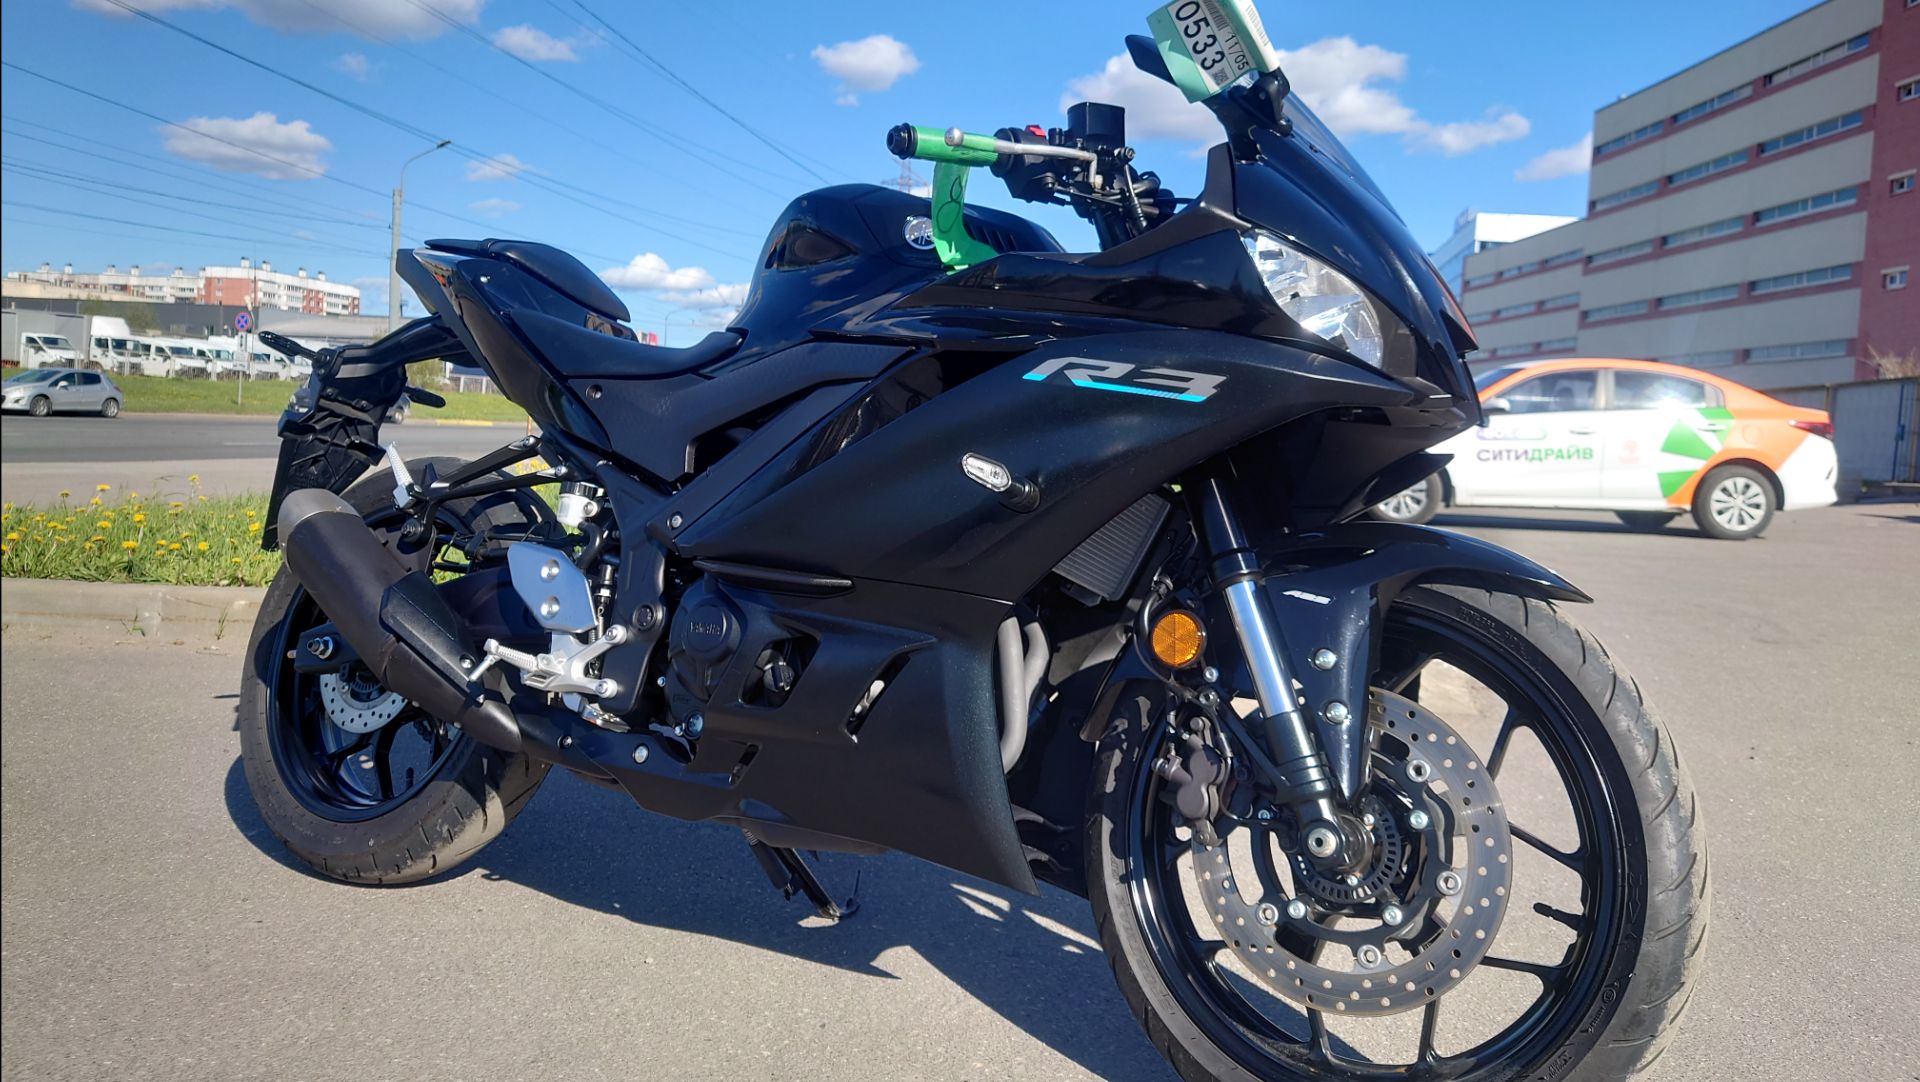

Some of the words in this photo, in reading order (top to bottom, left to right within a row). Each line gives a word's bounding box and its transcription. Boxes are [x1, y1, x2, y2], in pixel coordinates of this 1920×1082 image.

[1175, 1, 1225, 71] 0533
[1224, 32, 1249, 71] 11/05
[1022, 356, 1228, 403] R3
[1476, 446, 1593, 462] СИТИДРАЙВ
